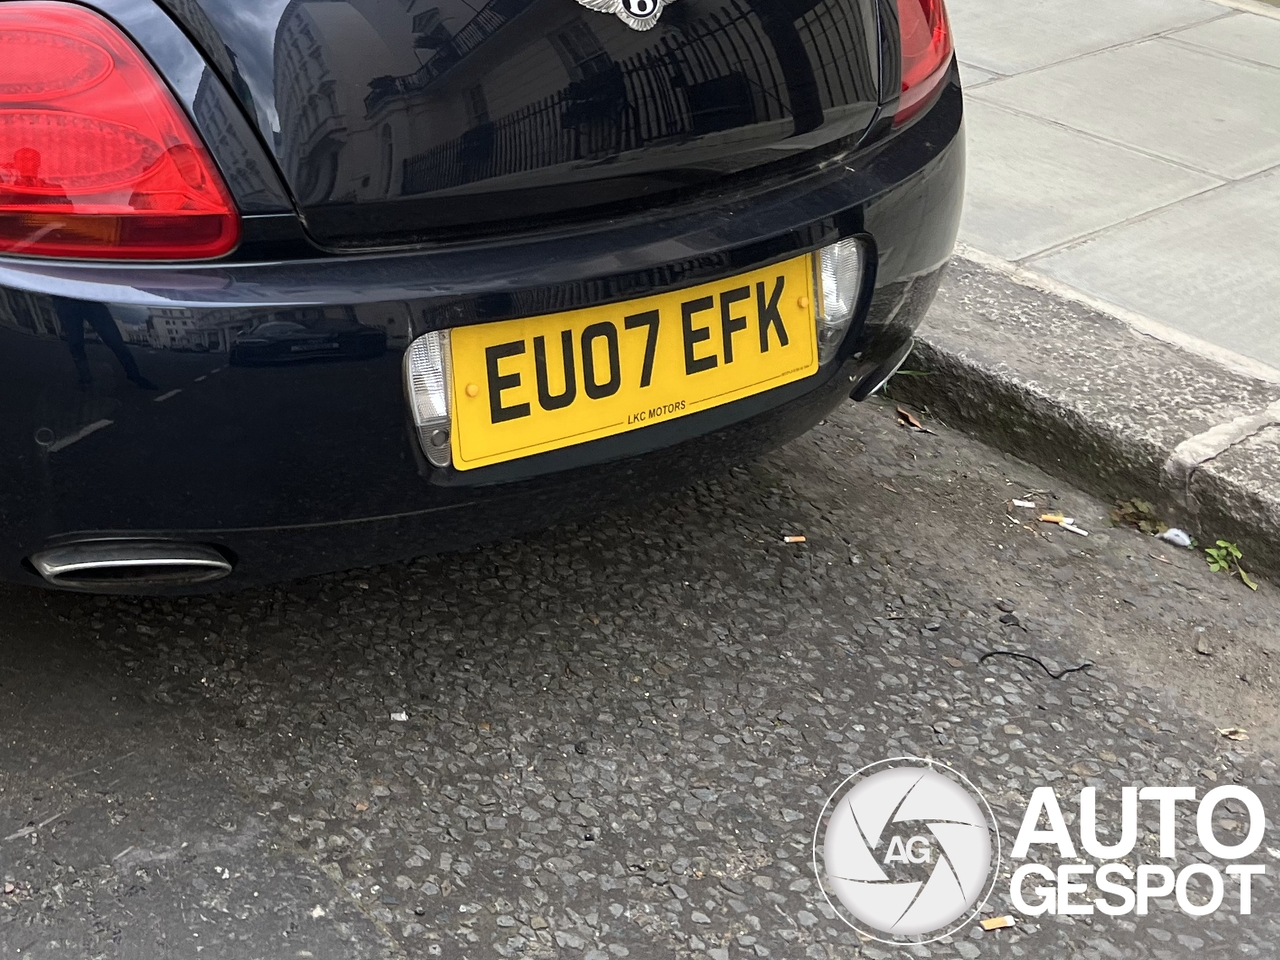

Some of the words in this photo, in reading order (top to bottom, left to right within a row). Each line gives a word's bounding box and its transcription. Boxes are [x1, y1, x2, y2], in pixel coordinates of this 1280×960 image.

[485, 309, 659, 424] EU07
[681, 276, 789, 376] EFK
[627, 411, 646, 425] LKC
[649, 400, 686, 419] MOTORS
